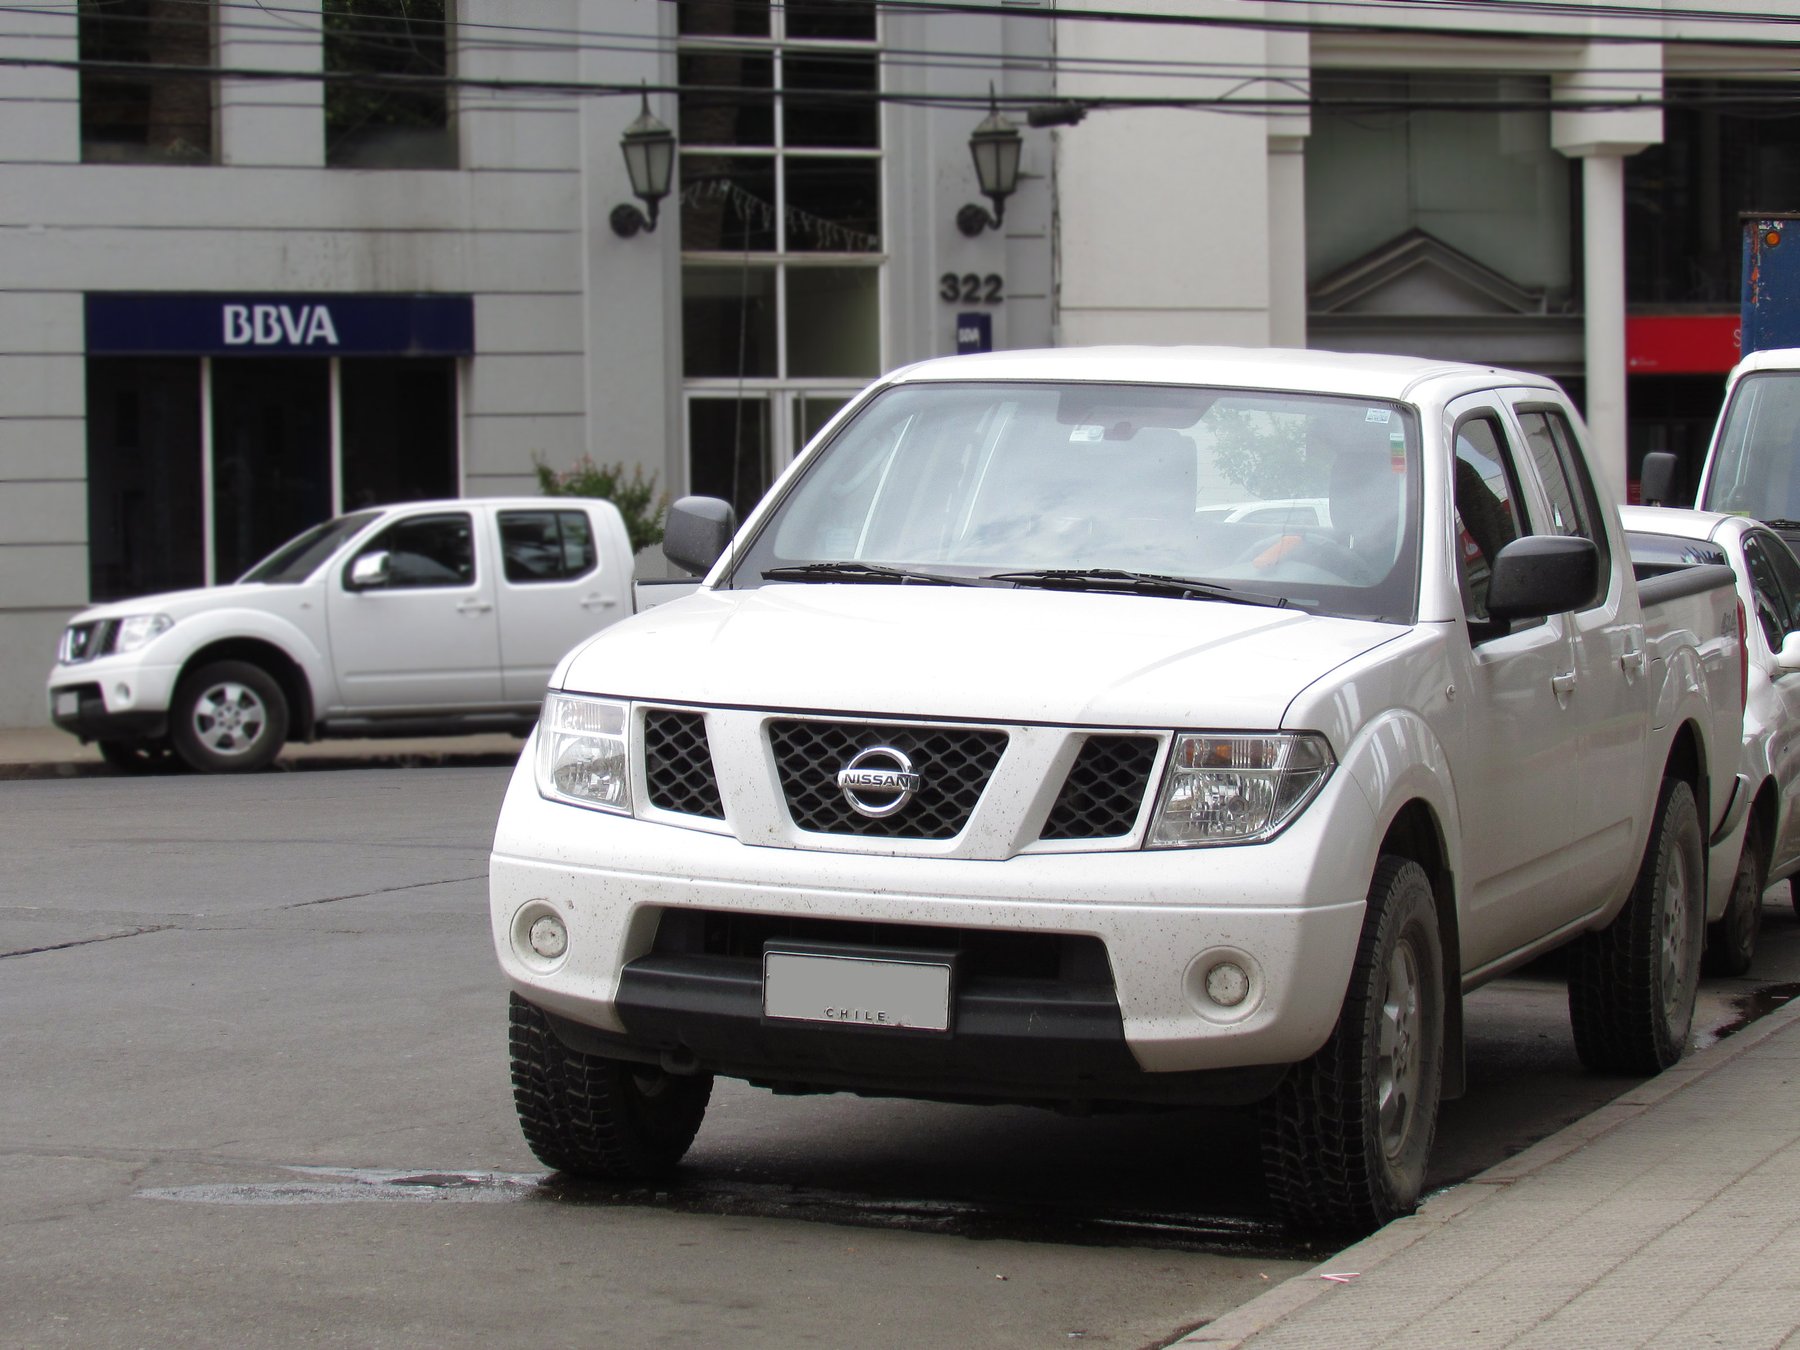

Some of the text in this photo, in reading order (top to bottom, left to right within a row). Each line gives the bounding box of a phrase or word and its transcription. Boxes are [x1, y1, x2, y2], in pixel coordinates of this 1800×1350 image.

[940, 272, 1004, 304] 322
[223, 304, 339, 345] BBVA
[844, 773, 909, 788] NISSAN
[826, 1007, 886, 1021] CHILE
